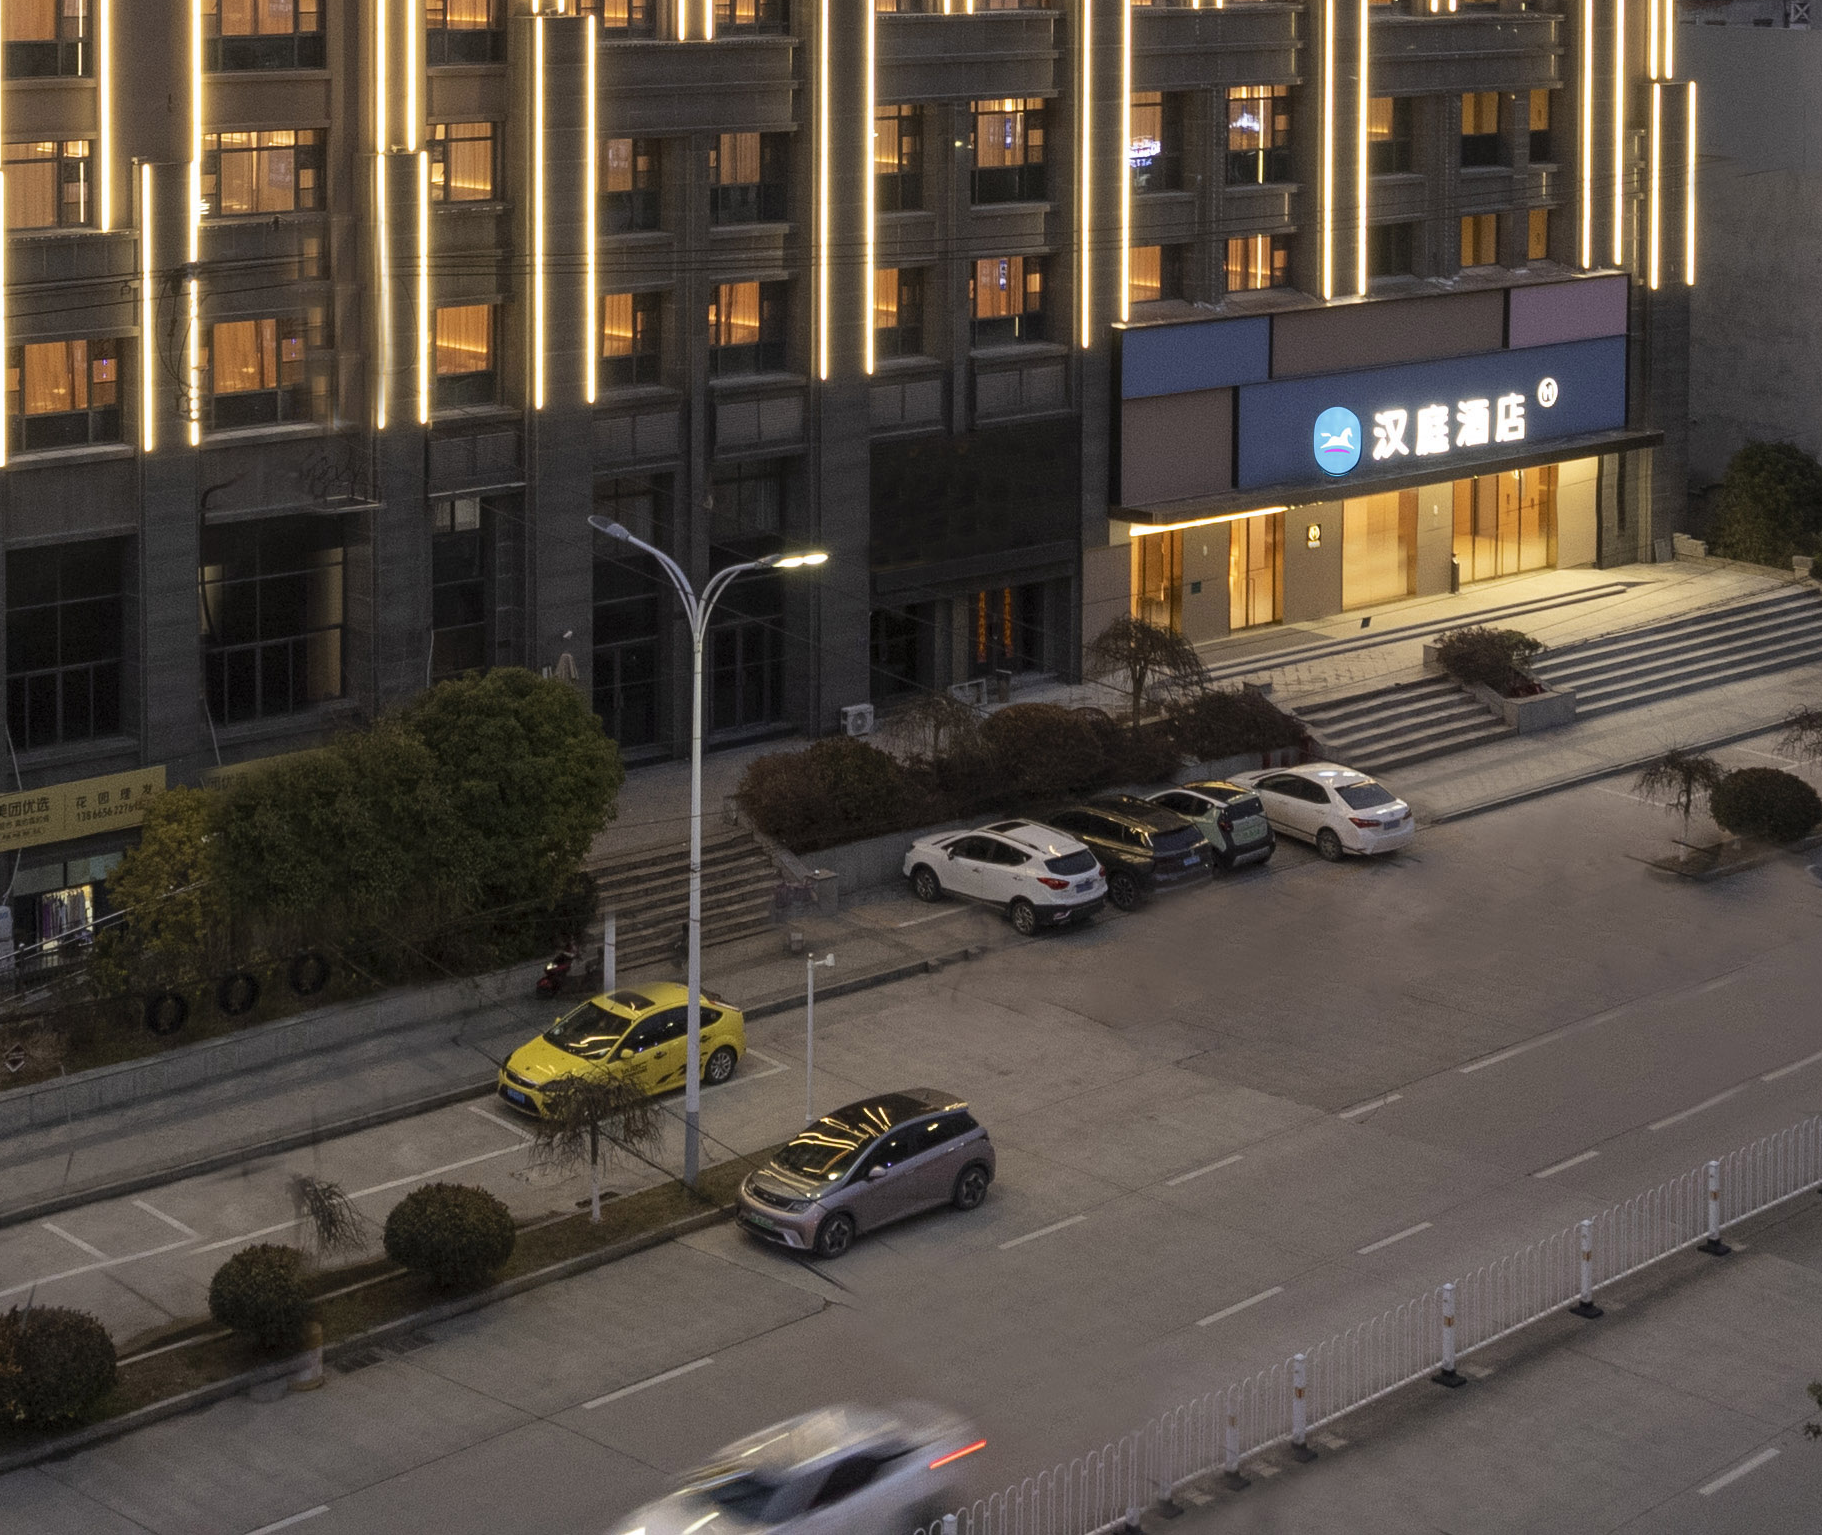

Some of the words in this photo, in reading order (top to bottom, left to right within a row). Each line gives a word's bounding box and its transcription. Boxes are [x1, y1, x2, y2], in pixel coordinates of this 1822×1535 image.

[1372, 392, 1526, 461] 汉庭酒店
[76, 783, 153, 809] 花园理发
